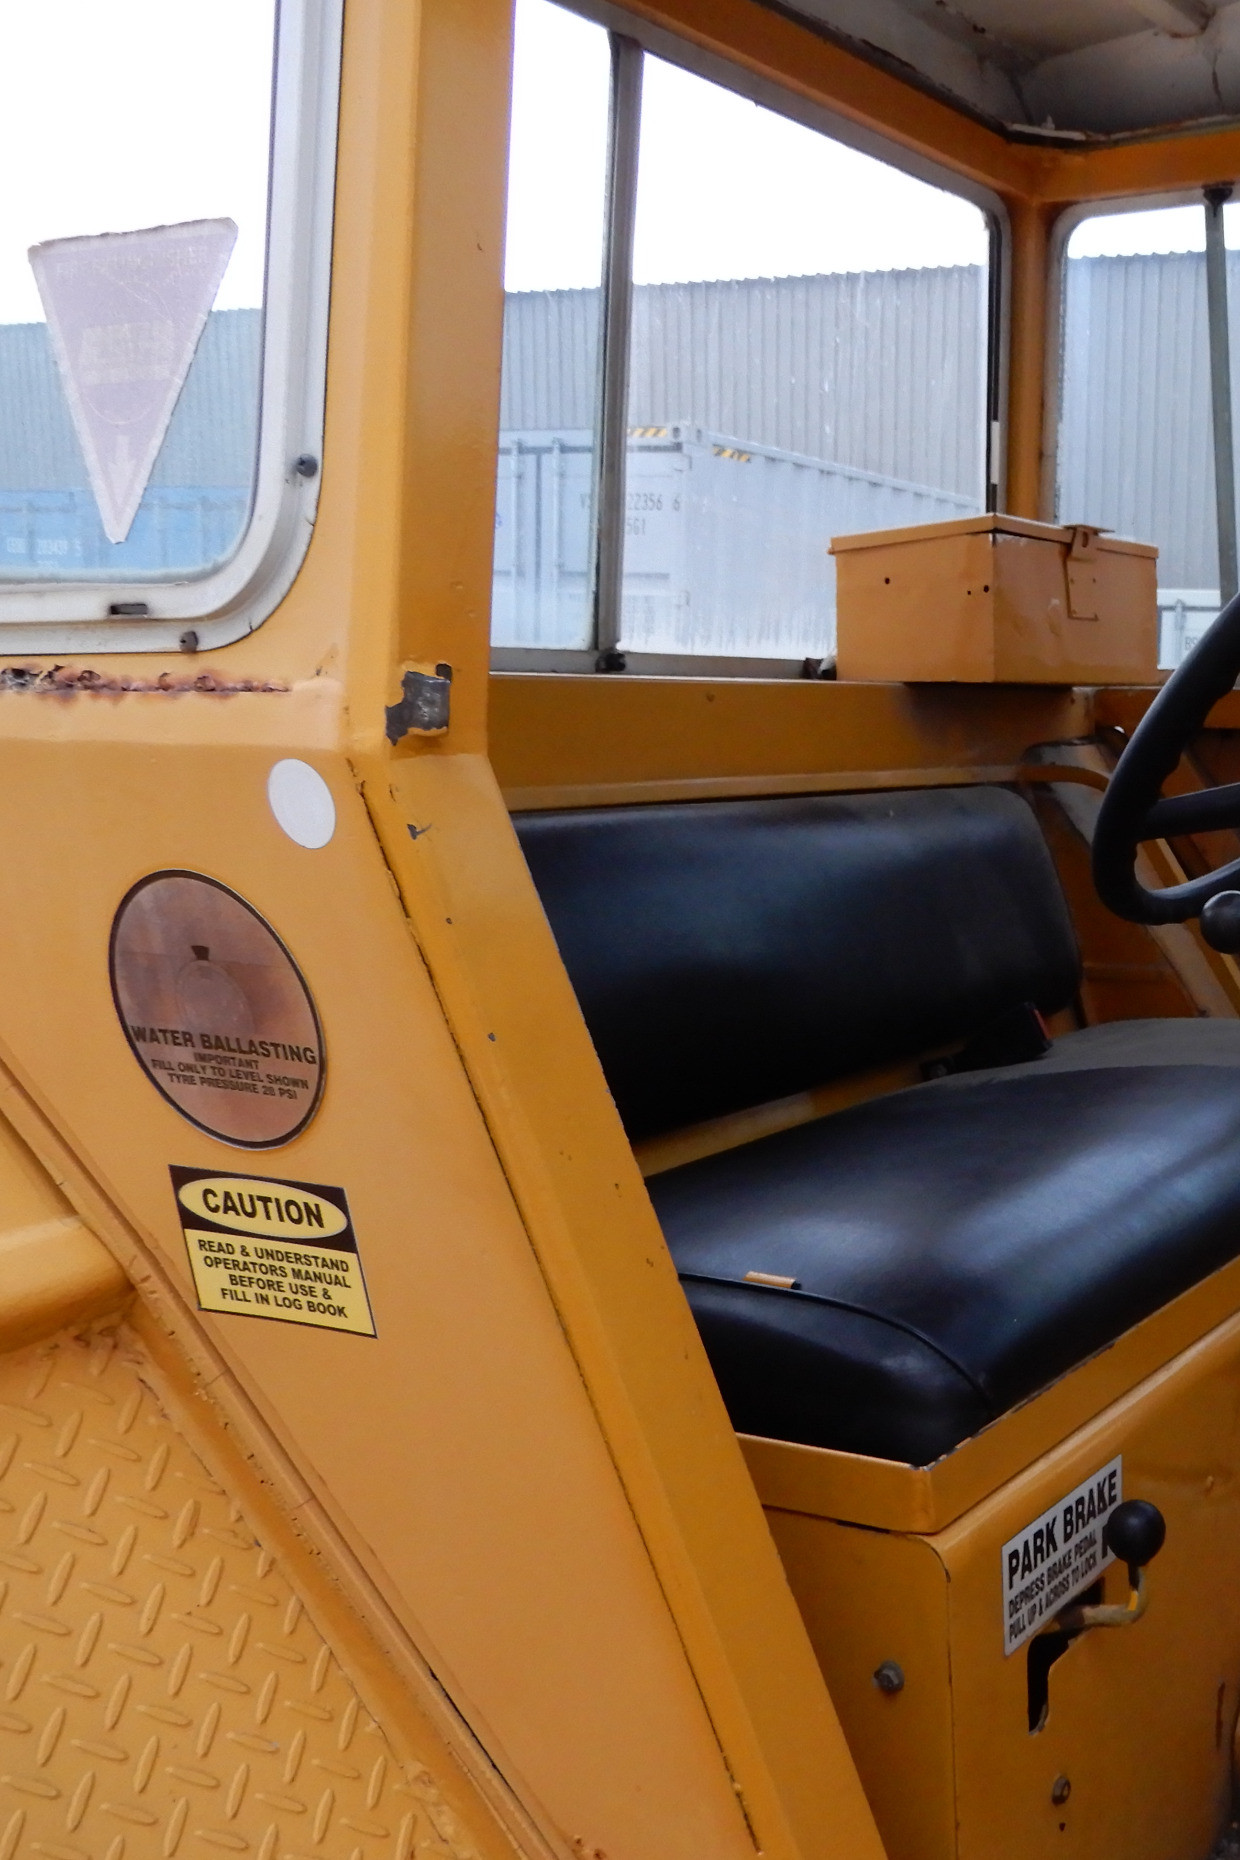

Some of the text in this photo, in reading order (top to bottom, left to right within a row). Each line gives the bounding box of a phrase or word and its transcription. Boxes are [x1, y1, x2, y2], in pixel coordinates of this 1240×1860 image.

[130, 1025, 317, 1064] WATER BALLASTING
[193, 1052, 259, 1069] IMPORTANT
[151, 1058, 309, 1089] FILL ONLY TO LEVEL SHOWN
[168, 1072, 197, 1086] TYRE
[200, 1076, 259, 1094] PRESSURE
[279, 1087, 298, 1100] PSI
[202, 1188, 325, 1229] CAUTION
[198, 1239, 349, 1272] READ & UNDERSTAND
[203, 1256, 351, 1289] OPERATORS MANUAL
[229, 1274, 332, 1300] BEFORE USE &
[220, 1288, 348, 1319] FILL IN LOG BOOK
[1008, 1469, 1117, 1591] PARK BRAKE
[1008, 1573, 1045, 1619] DEPRESS
[1047, 1549, 1072, 1586] BRAKE
[1009, 1613, 1026, 1644] PULL
